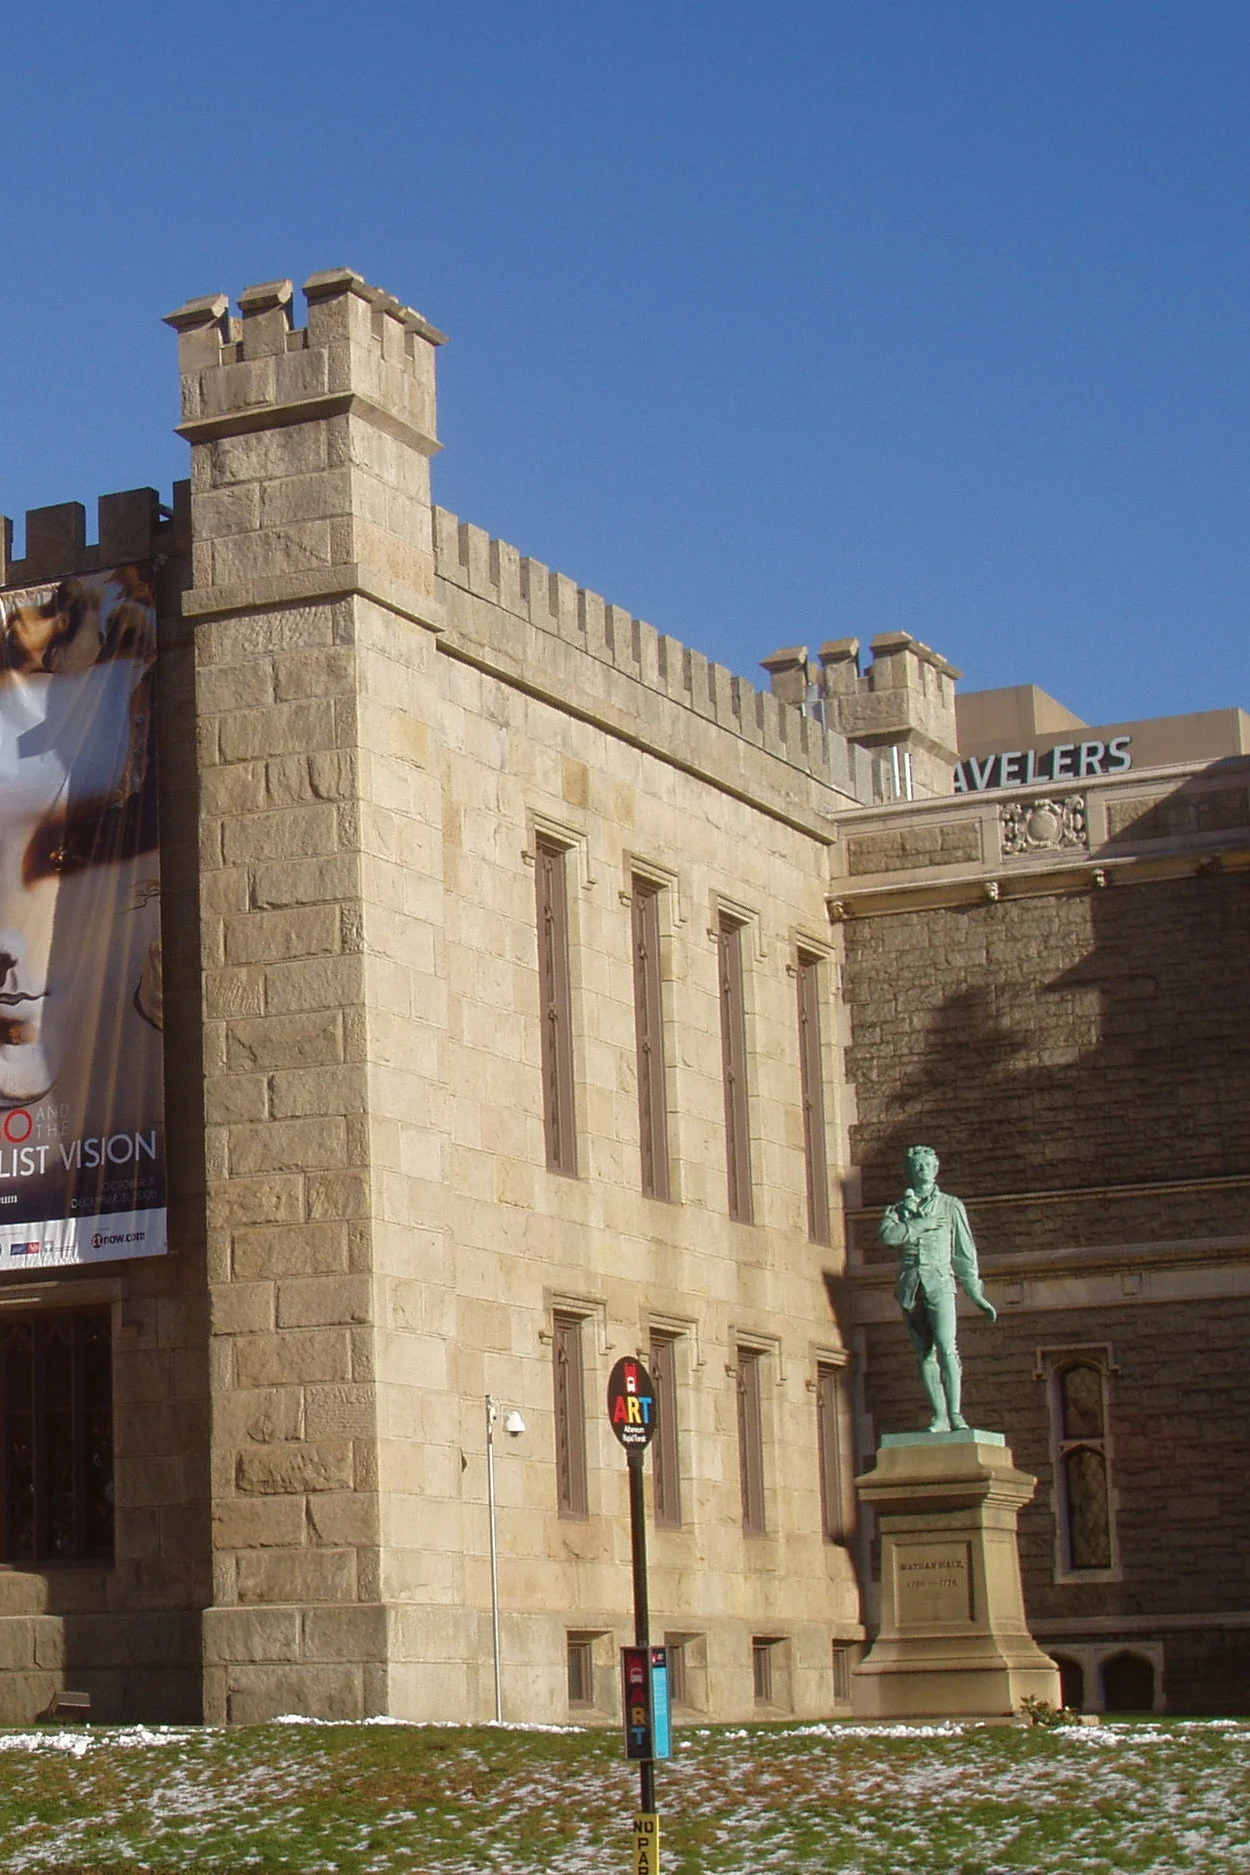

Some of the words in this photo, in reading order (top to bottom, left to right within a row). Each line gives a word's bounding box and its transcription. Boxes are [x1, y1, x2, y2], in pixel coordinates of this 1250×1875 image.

[36, 1103, 70, 1121] AND
[36, 1120, 69, 1140] THE
[60, 1130, 157, 1170] VISION
[614, 1396, 653, 1424] ART
[900, 1560, 936, 1570] NATHAN
[634, 1820, 654, 1833] NO
